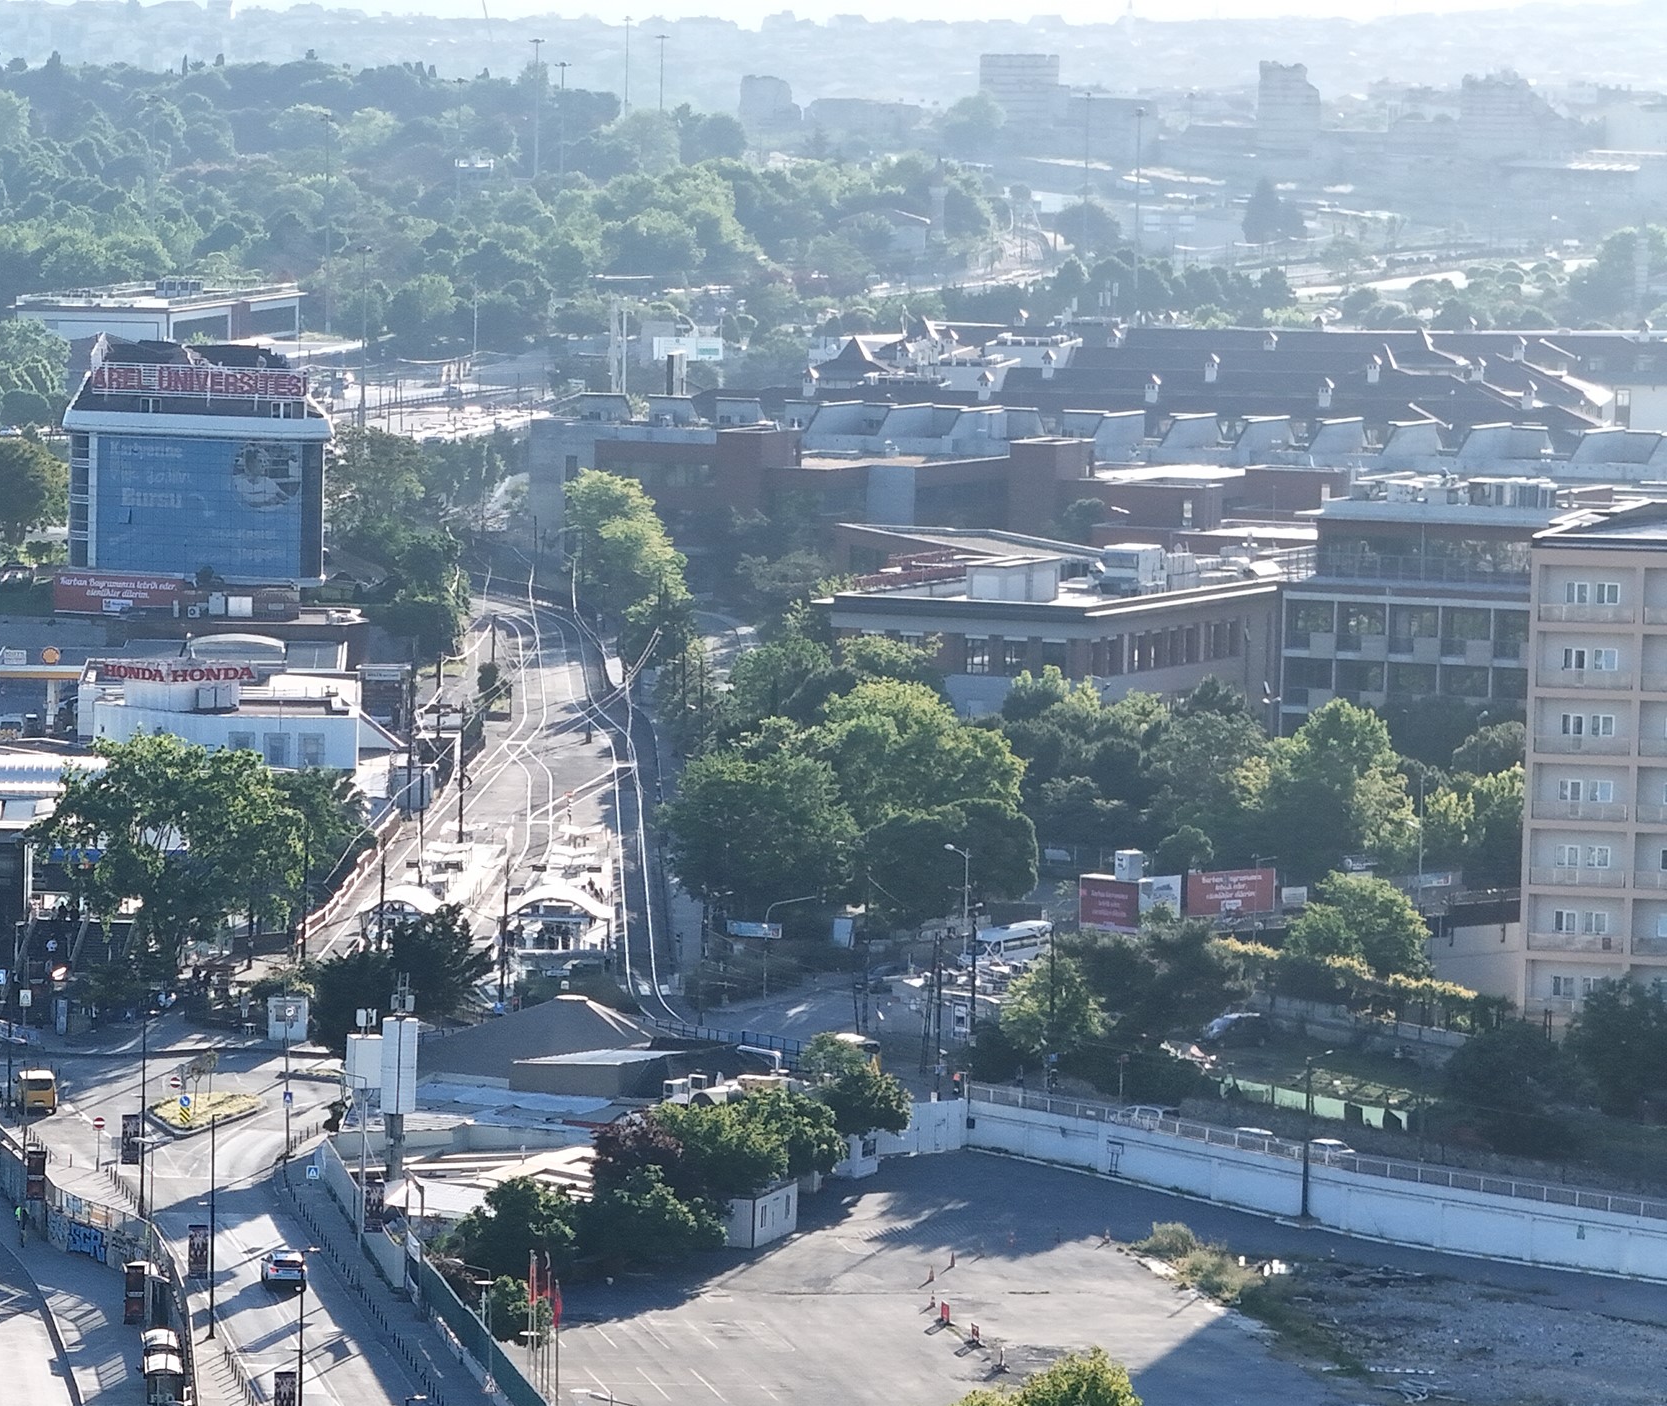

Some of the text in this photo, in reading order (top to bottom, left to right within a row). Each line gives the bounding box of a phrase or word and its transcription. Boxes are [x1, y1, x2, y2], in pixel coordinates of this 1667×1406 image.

[92, 366, 143, 390] AREL
[104, 664, 256, 683] HONDA HONDA
